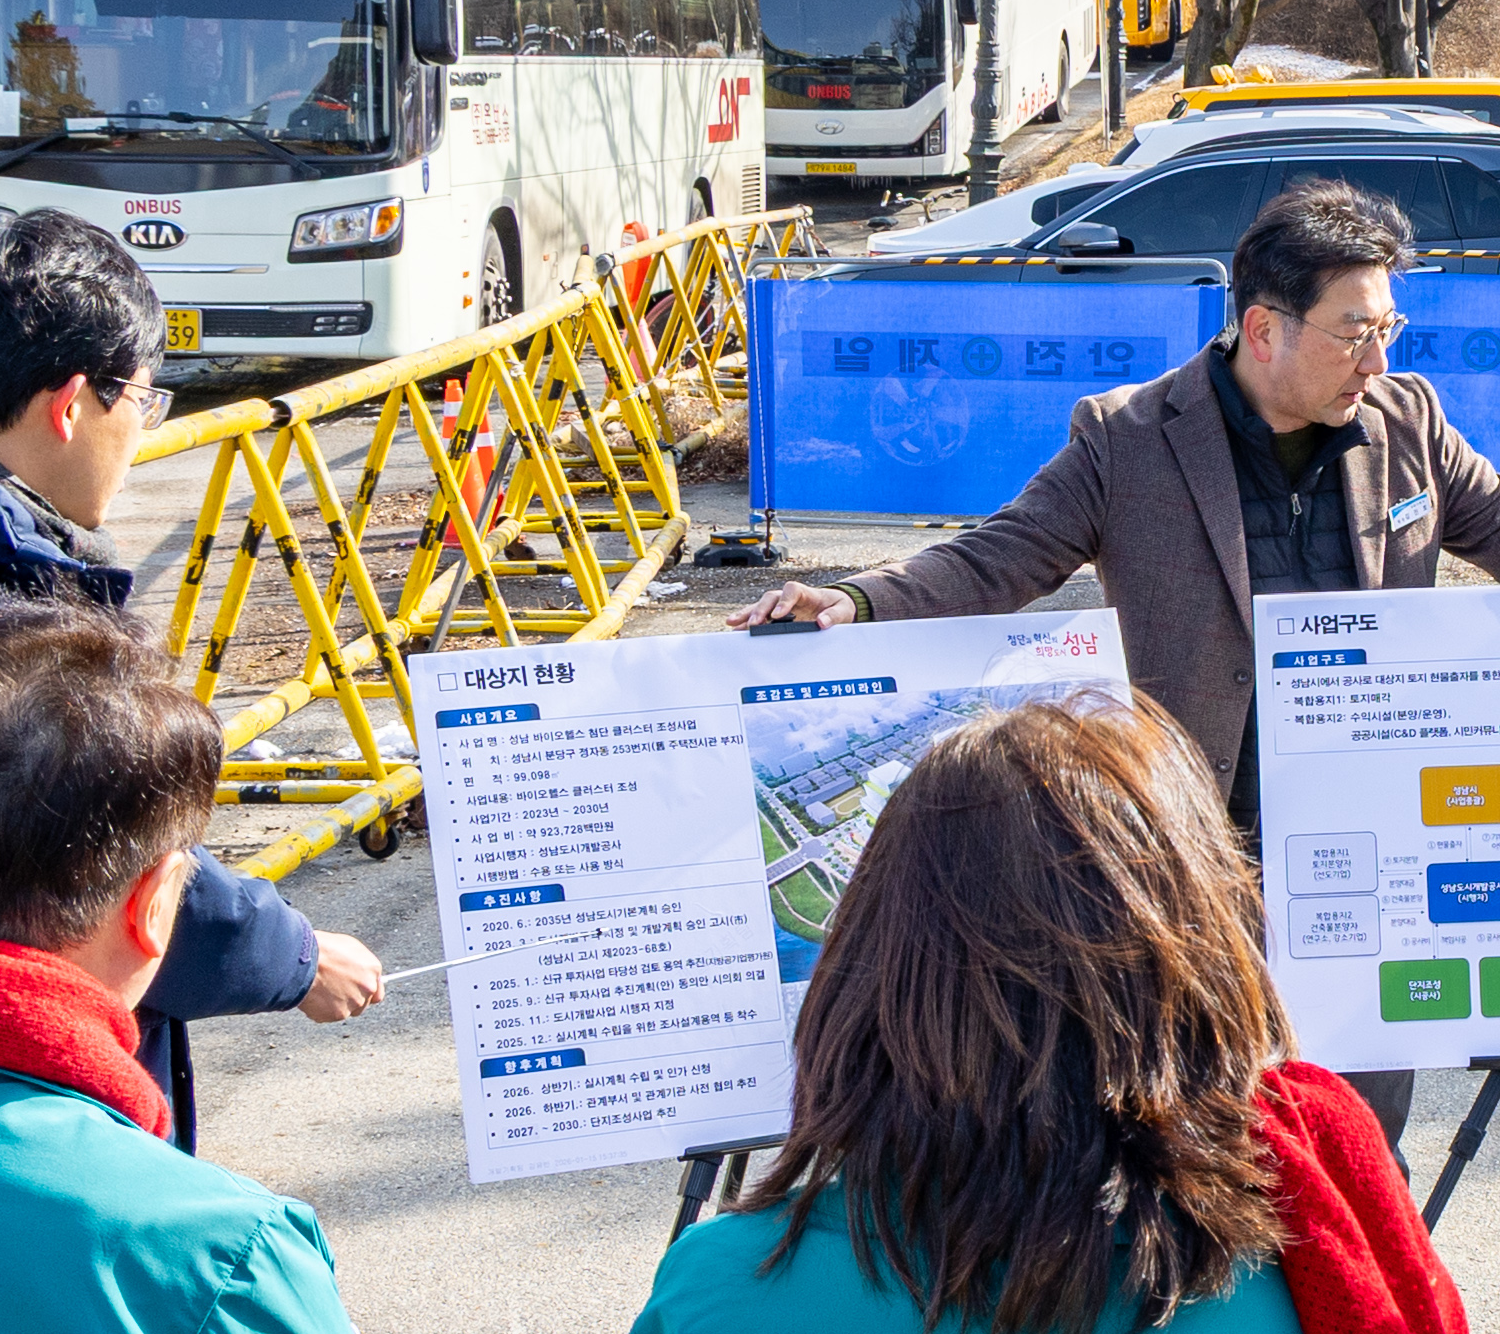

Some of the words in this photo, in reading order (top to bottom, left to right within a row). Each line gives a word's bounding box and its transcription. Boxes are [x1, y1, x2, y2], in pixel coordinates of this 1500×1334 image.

[807, 84, 851, 100] ONBUS
[124, 199, 182, 215] ONBUS
[130, 224, 177, 245] KIA
[1300, 613, 1379, 635] 사업구도
[1062, 631, 1099, 657] 성남
[1294, 654, 1346, 666] 사업구도
[463, 664, 528, 690] 대상지
[532, 661, 576, 685] 현황
[1290, 676, 1340, 689] 성남시에서
[1342, 674, 1373, 687] 공사로
[1374, 673, 1405, 685] 대상지
[1406, 672, 1427, 683] 토지
[800, 686, 812, 699] 및
[508, 733, 529, 746] 성남
[532, 729, 586, 743] 바이오헬스
[587, 726, 609, 739] 첨단
[611, 722, 653, 737] 클러스터
[656, 719, 697, 732] 조성사업
[510, 750, 542, 765] 성남시
[544, 748, 576, 761] 분당구
[578, 745, 609, 759] 정자동
[668, 736, 718, 750] 주택전시관
[720, 733, 744, 746] 부지)
[515, 787, 569, 802] 바이오헬스
[572, 782, 614, 797] 클러스터
[616, 780, 638, 792] 조성
[1452, 784, 1478, 796] 성남시
[1313, 847, 1350, 859] 복합용지1
[1457, 892, 1489, 904] (시행자)
[481, 919, 513, 933] 2020.
[534, 912, 572, 927] 2035년
[574, 903, 658, 924] 성남도시기본계획
[660, 901, 682, 915] 승인
[1315, 910, 1353, 922] 복합용지2
[1408, 979, 1441, 991] 단지조성
[495, 1036, 527, 1050] 2025.
[555, 1027, 598, 1043] 실시계획
[600, 1023, 632, 1037] 수립을
[635, 1020, 656, 1033] 위한
[659, 1012, 721, 1030] 조사설계용역
[723, 1011, 734, 1023] 등
[736, 1008, 758, 1021] 착수
[502, 1085, 534, 1099] 2026.
[584, 1073, 626, 1089] 실시계획
[629, 1070, 650, 1084] 수립
[652, 1068, 664, 1081] 및
[666, 1065, 688, 1079] 인가
[690, 1062, 711, 1076] 신청
[506, 1125, 538, 1139] 2027.
[589, 1109, 653, 1128] 단지조성사업
[656, 1105, 677, 1118] 추진
